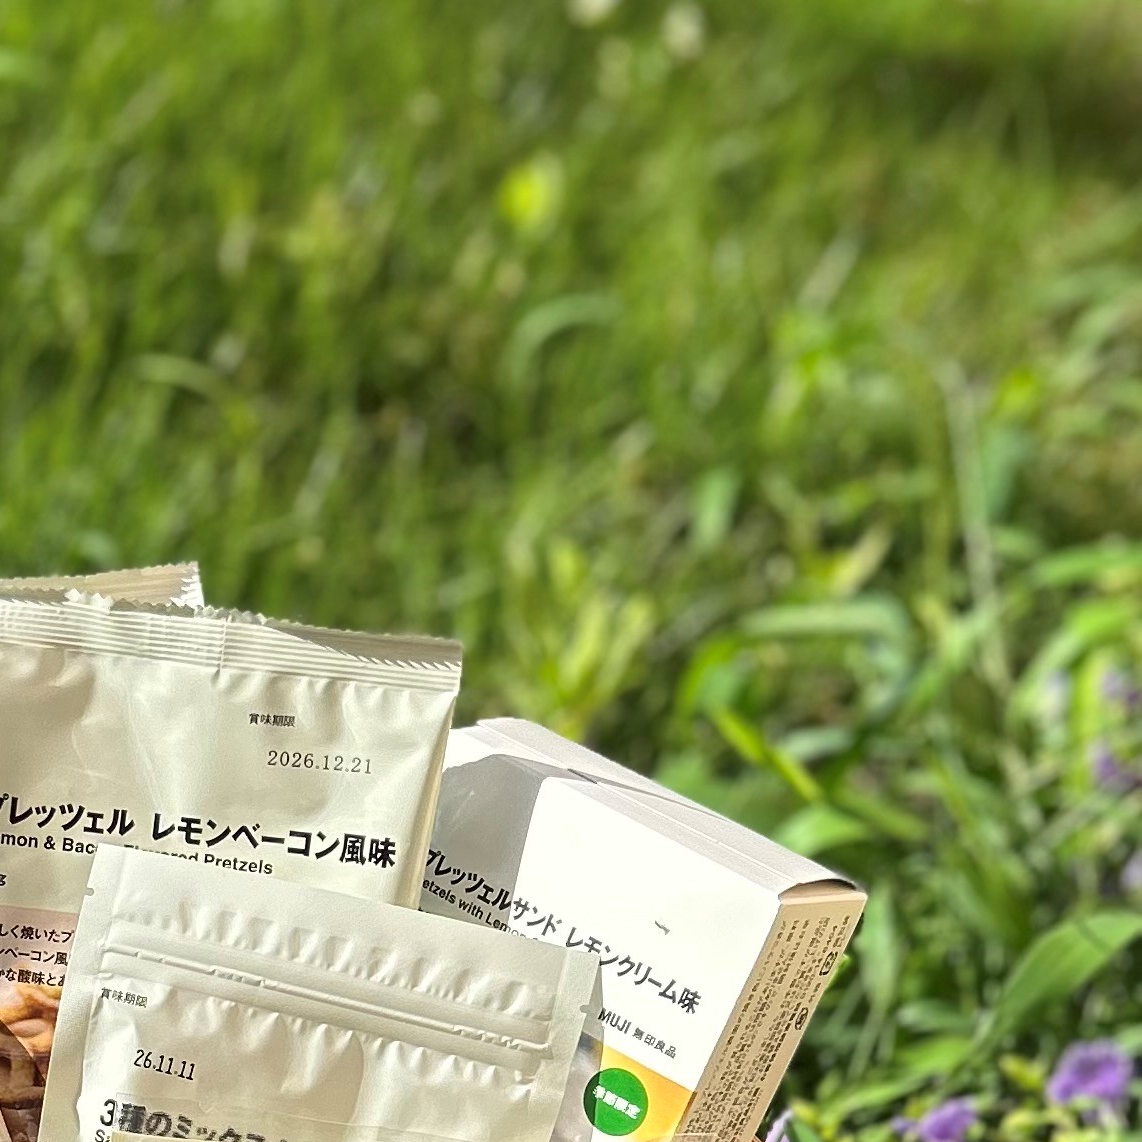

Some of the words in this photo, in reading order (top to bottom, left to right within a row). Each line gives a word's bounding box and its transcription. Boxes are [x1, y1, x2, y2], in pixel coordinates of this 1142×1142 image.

[248, 712, 296, 729] 賞味期限
[266, 749, 373, 775] 2026.12.21
[43, 834, 56, 851] &
[61, 837, 98, 856] Bac
[203, 852, 274, 876] Pretzels
[151, 812, 397, 869] レモンベーコン風味
[422, 878, 456, 905] etzels
[458, 898, 484, 920] with
[425, 848, 562, 937] プレッツェルサンド
[565, 926, 702, 1014] レモンクリーム味
[99, 986, 148, 1009] 賞味期限
[597, 1007, 632, 1035] MUJI
[631, 1027, 678, 1060] 無印良品
[133, 1049, 196, 1081] 26.11.11
